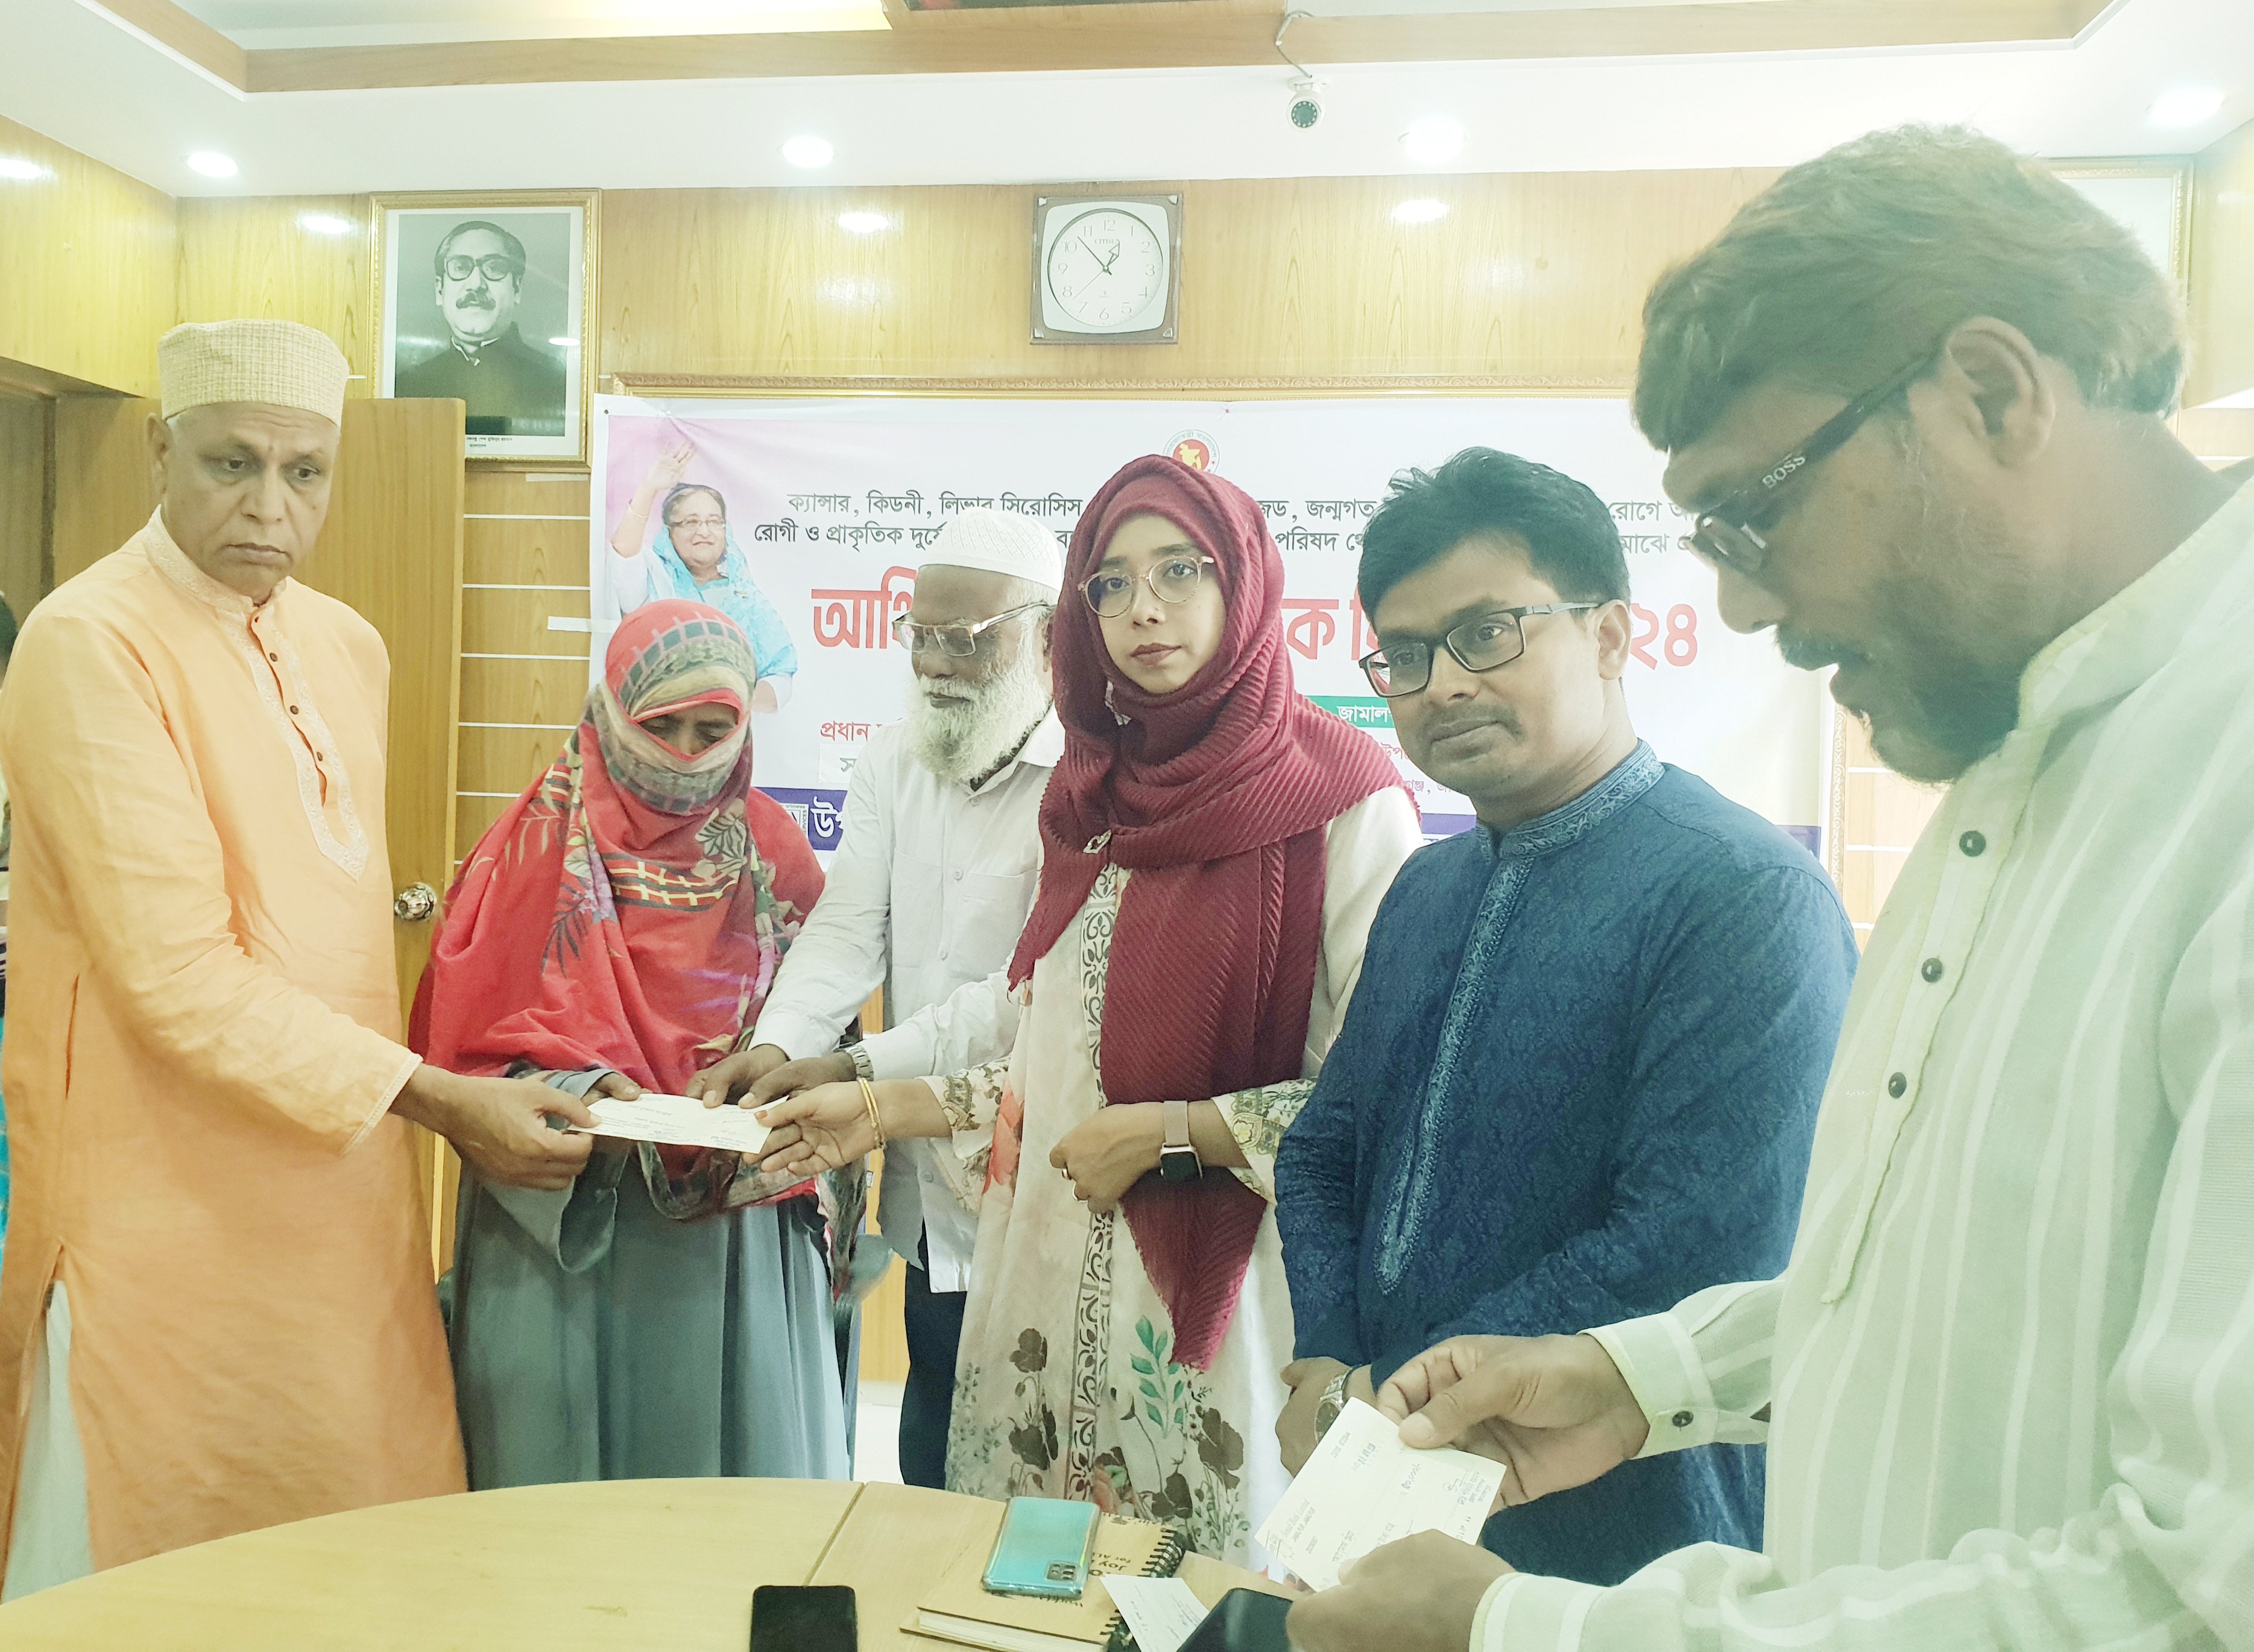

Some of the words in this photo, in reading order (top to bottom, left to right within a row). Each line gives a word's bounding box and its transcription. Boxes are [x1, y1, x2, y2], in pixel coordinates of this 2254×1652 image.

[1762, 456, 1805, 488] BOSS
[866, 489, 932, 519] কিডনী,
[1000, 491, 1083, 516] সিরোসিস
[754, 517, 799, 543] রোগী
[806, 526, 819, 541] ও
[827, 521, 904, 552] প্রাকৃতিক
[1275, 526, 1340, 552] পরিষদ
[1280, 599, 1339, 660] ক
[1629, 603, 1697, 670] ২৪
[1336, 705, 1391, 723] জামাল
[820, 720, 871, 742] প্রধান
